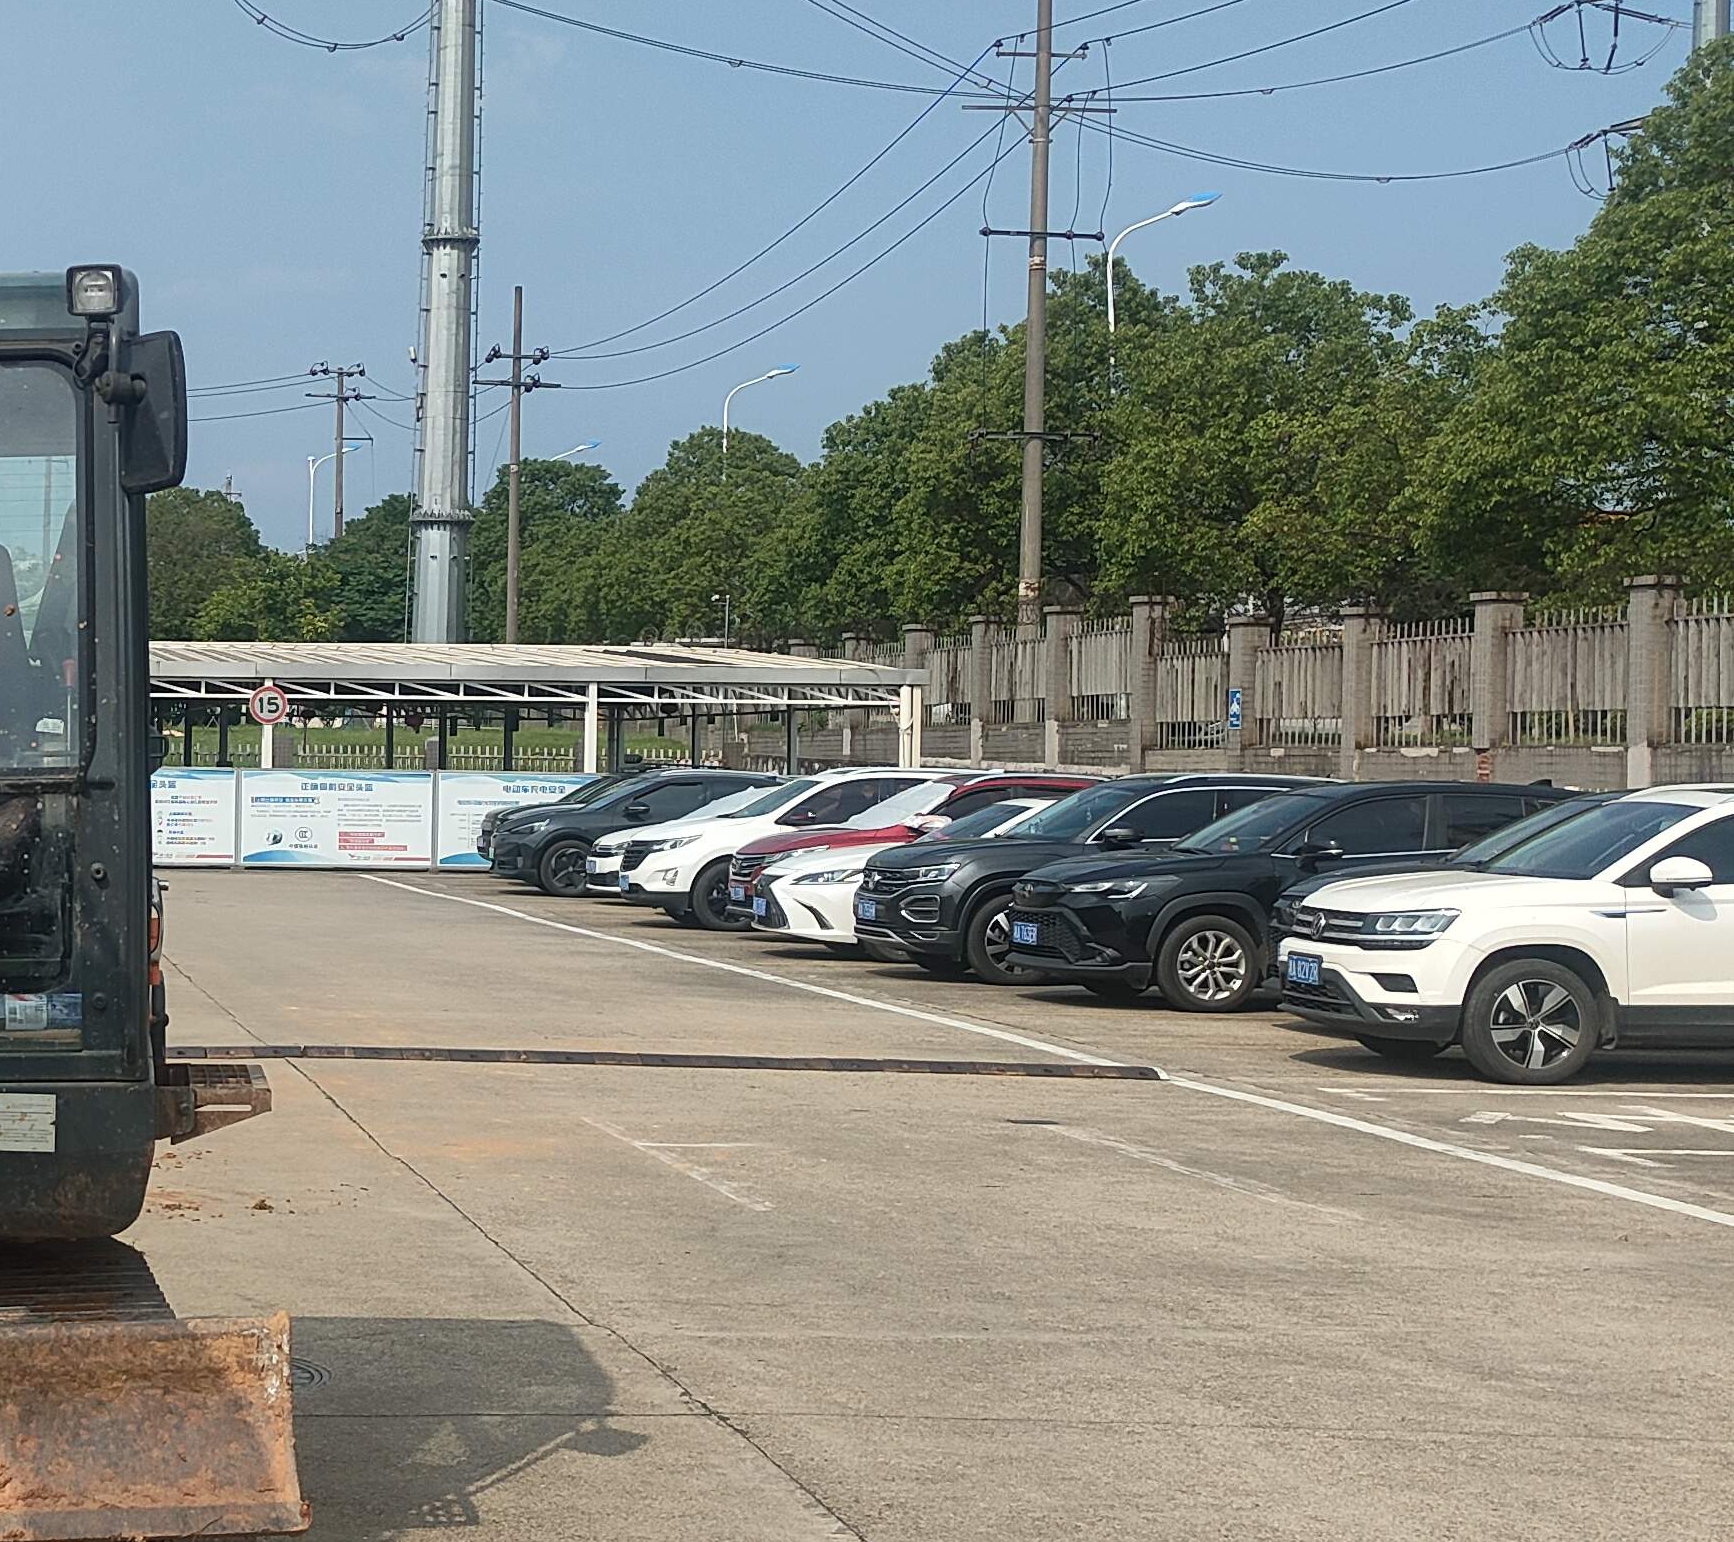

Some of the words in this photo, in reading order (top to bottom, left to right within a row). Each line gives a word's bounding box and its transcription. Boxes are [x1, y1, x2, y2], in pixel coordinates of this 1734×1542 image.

[258, 696, 280, 713] 15
[502, 784, 566, 794] 电动车充电安全
